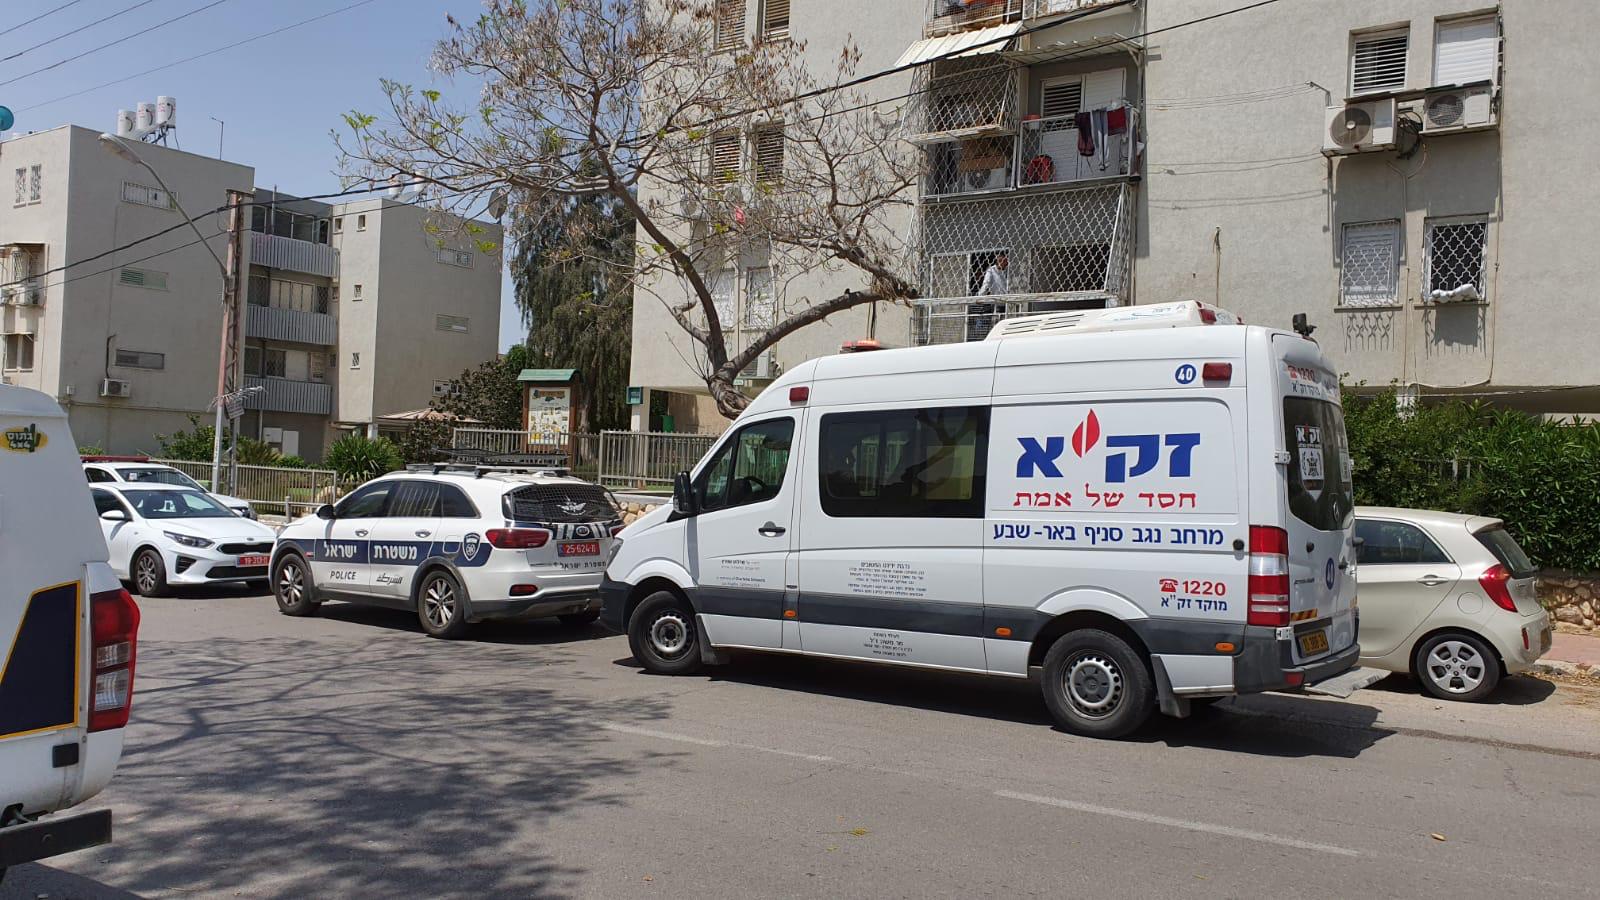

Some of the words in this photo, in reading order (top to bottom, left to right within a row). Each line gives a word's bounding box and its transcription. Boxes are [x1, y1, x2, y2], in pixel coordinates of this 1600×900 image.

[1177, 367, 1193, 381] 40
[1013, 491, 1072, 507] אמת
[1085, 483, 1124, 508] של
[1138, 492, 1196, 508] חסד
[1084, 526, 1123, 545] סניף
[1132, 527, 1162, 543] נגב
[1170, 528, 1224, 545] מרחב
[323, 540, 357, 558] ישראל
[373, 545, 418, 560] משטרת
[329, 570, 357, 580] POLICE
[1183, 580, 1226, 596] 1220
[1195, 600, 1228, 611] מוקד
